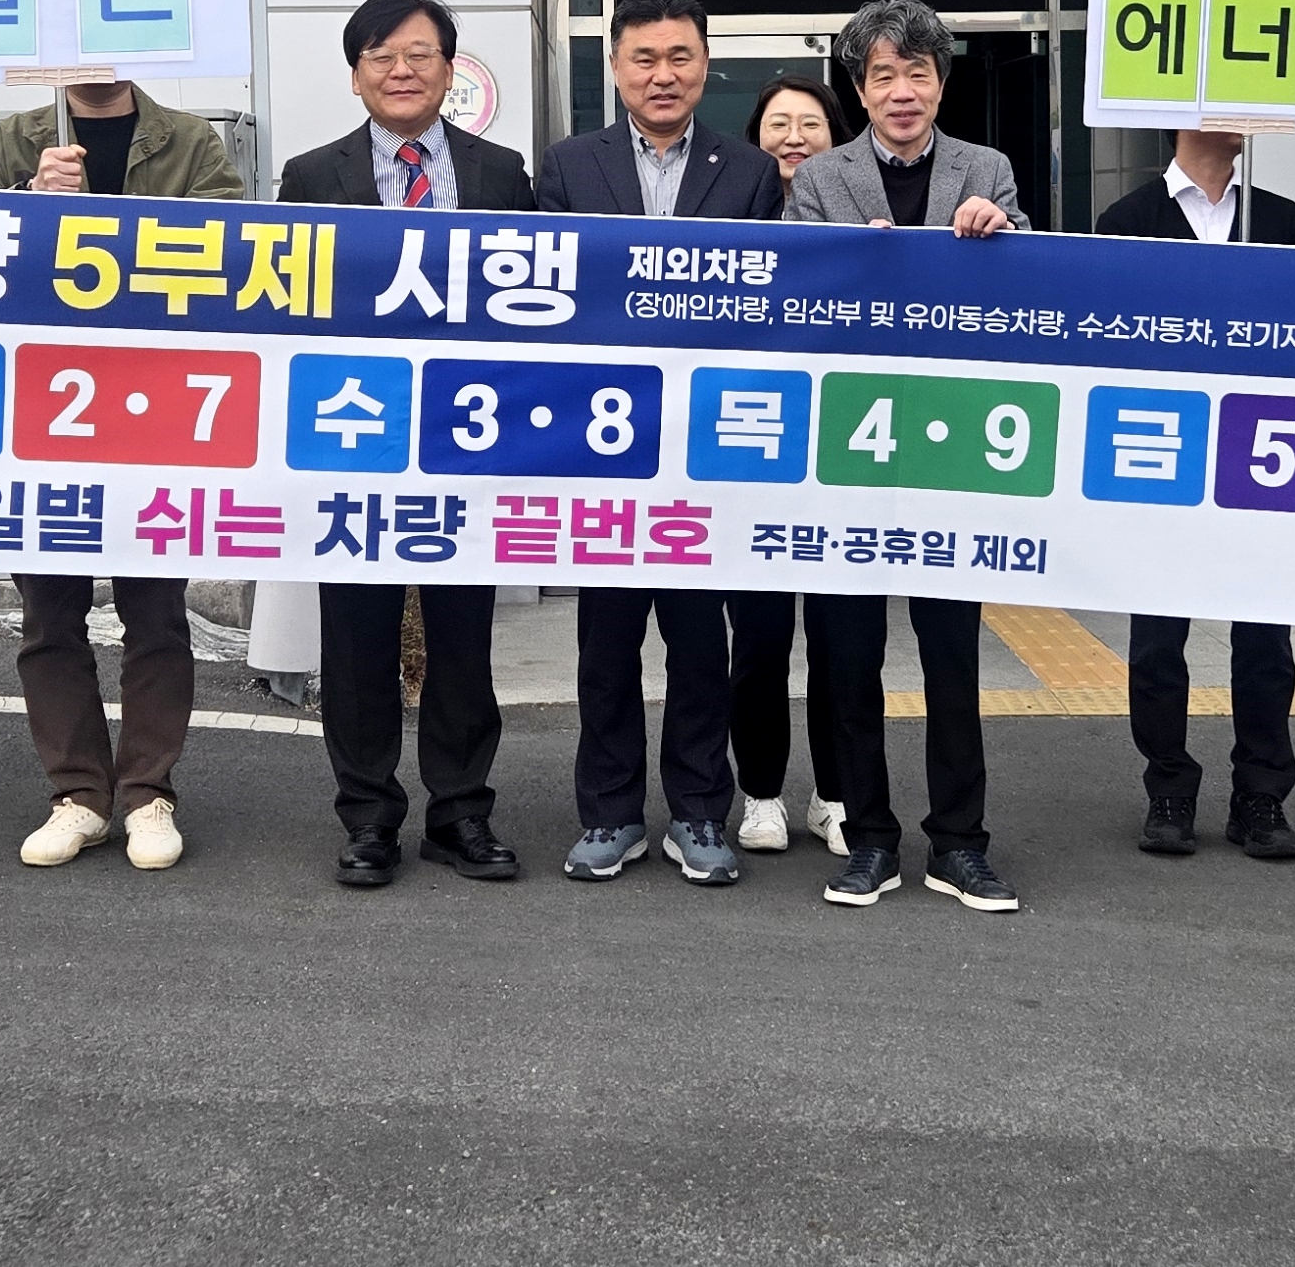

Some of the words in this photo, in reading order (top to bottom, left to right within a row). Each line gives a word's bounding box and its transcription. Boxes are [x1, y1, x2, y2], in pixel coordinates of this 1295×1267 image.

[52, 215, 336, 318] 5부제
[375, 227, 579, 326] 시행
[627, 246, 778, 285] 제외차량
[624, 291, 774, 325] (장애인차량,
[782, 298, 862, 327] 임산부
[870, 302, 895, 328] 및
[902, 303, 1069, 340] 유아동승차량,
[1077, 312, 1218, 347] 수소자동차,
[314, 377, 385, 449] 수
[714, 390, 785, 461] 목
[1110, 409, 1184, 483] 금
[135, 486, 286, 558] 쉬는
[314, 492, 468, 563] 차량
[492, 495, 714, 567] 끝번호
[751, 523, 957, 568] 주말·공휴일
[970, 534, 1048, 574] 제외
